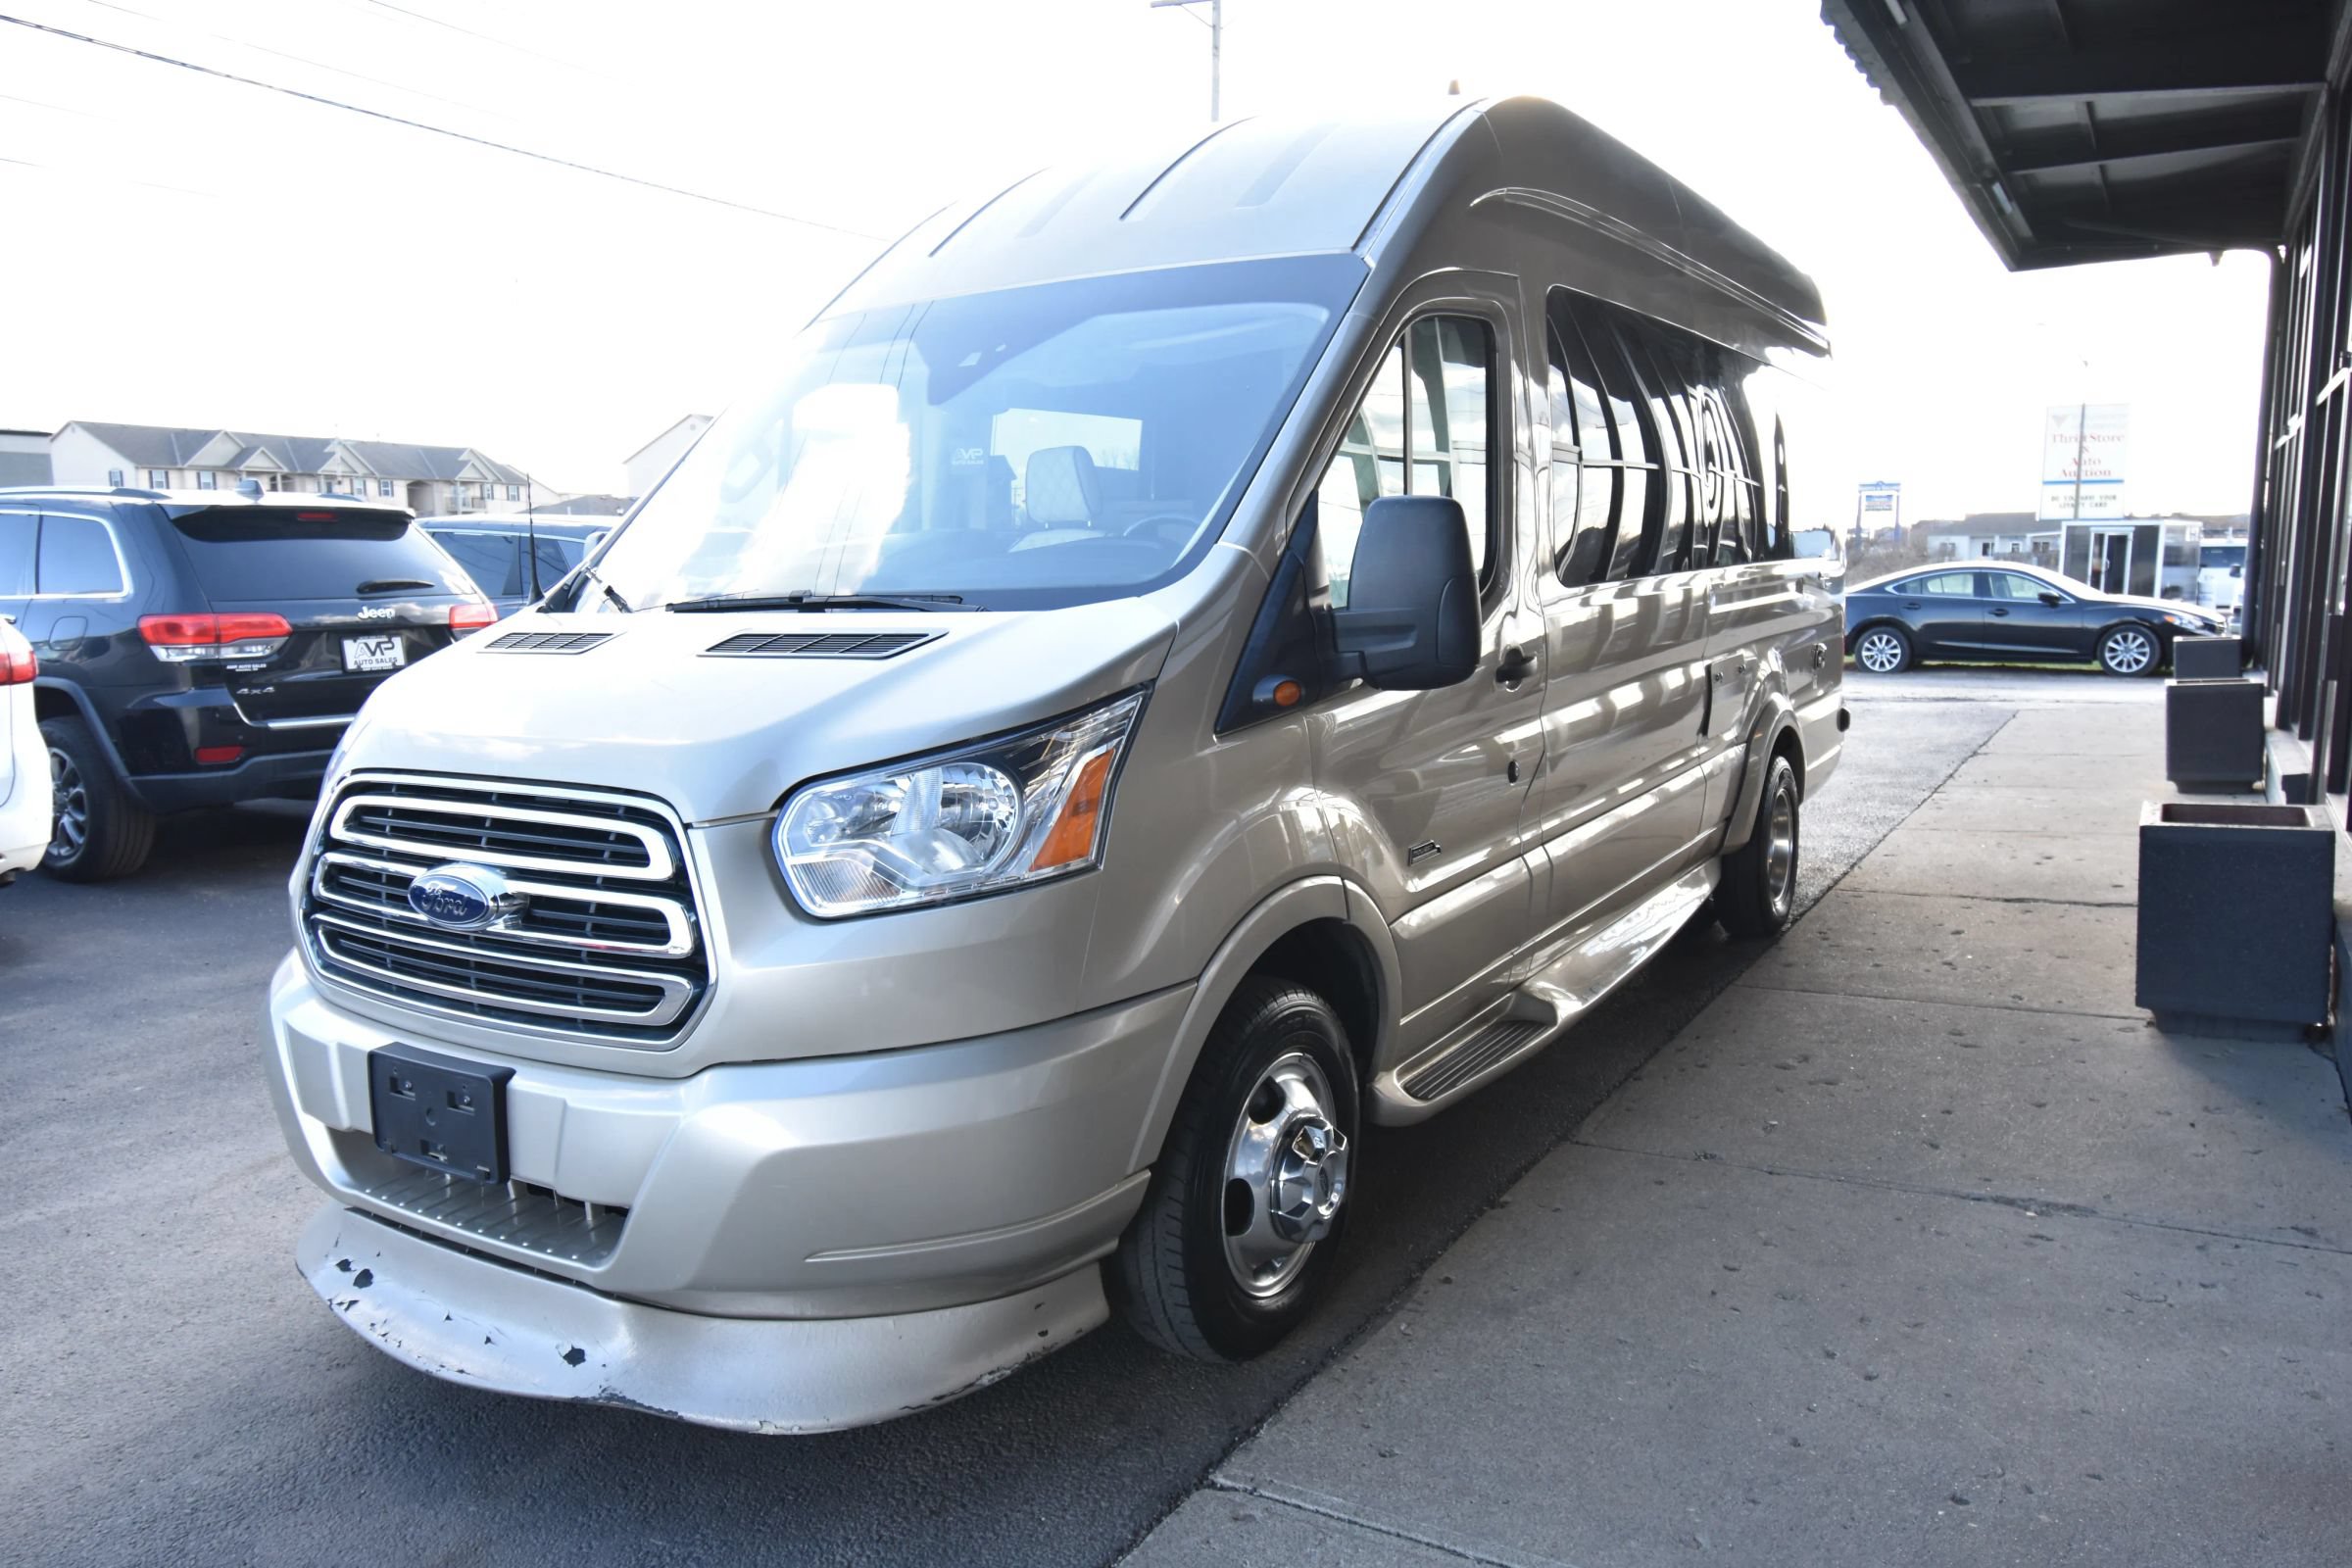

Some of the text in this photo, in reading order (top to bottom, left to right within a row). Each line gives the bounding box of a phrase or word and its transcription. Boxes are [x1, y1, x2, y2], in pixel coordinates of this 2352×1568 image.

[2063, 468, 2112, 477] Aution
[358, 606, 396, 619] Jeep
[421, 880, 467, 916] Ford
